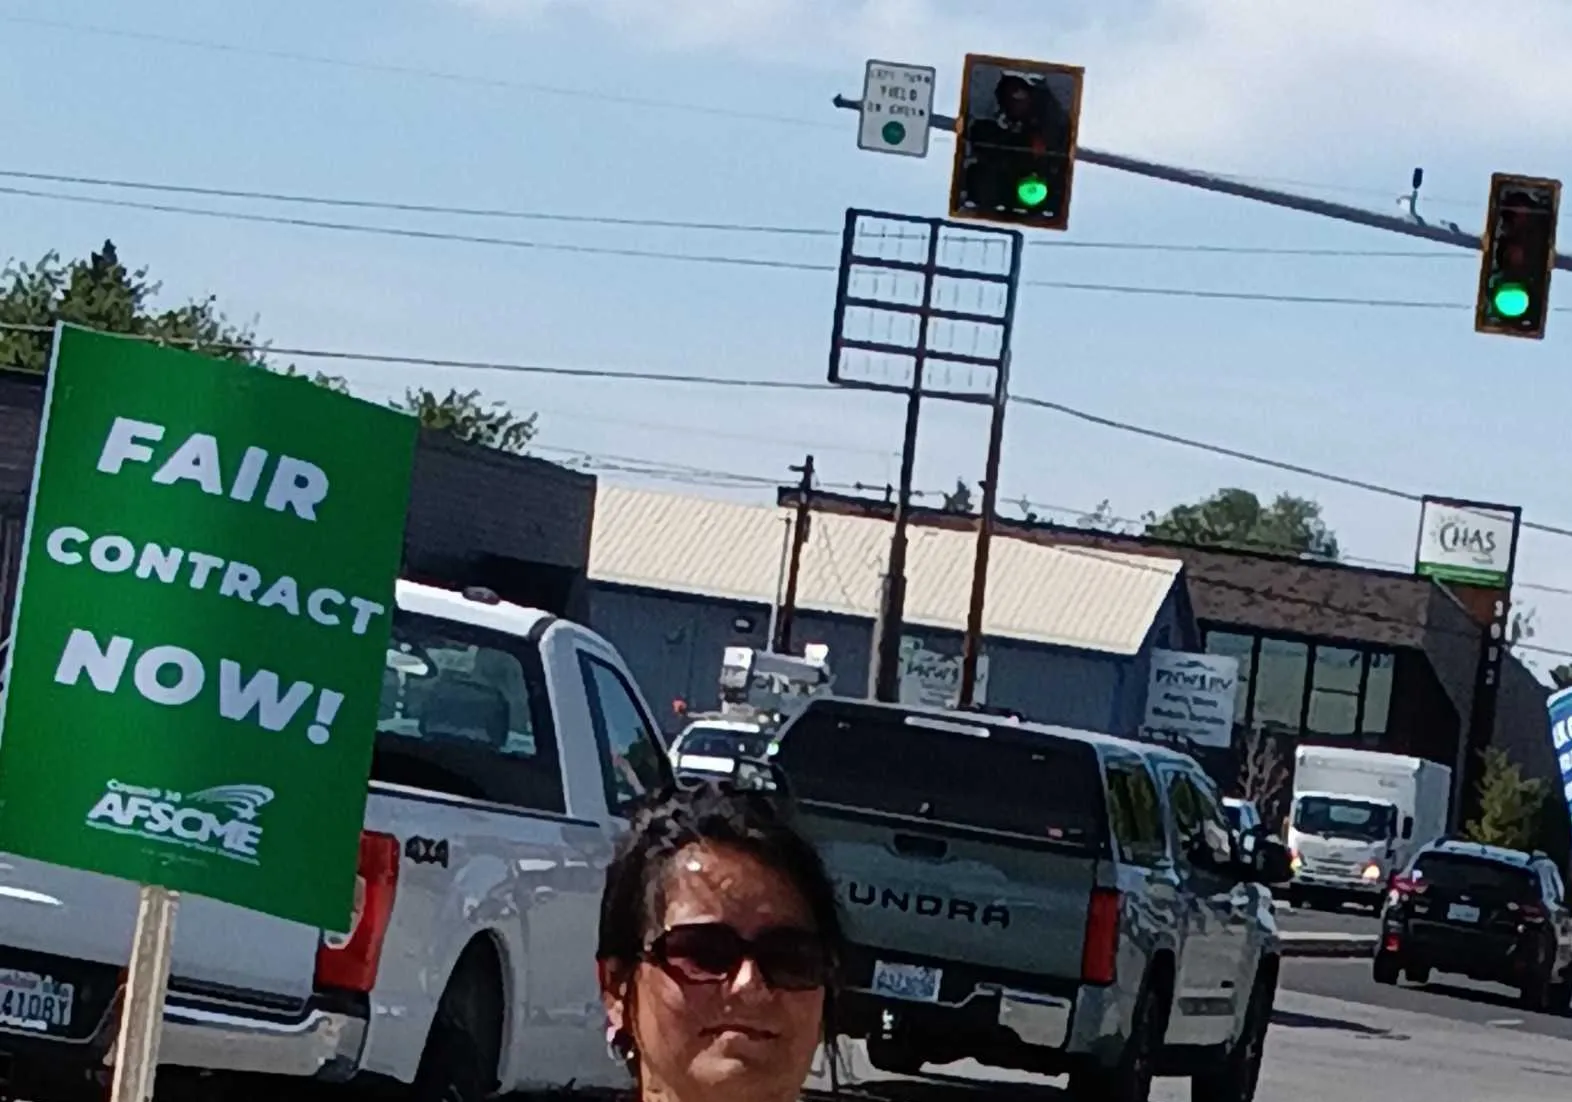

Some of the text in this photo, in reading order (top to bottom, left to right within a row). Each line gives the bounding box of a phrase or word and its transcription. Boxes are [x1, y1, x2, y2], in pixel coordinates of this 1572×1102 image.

[96, 416, 330, 522] FAIR
[1439, 521, 1497, 553] CHAS
[46, 526, 385, 635] CONTRACT
[53, 628, 345, 745] NOW!
[87, 791, 264, 856] AFSCME
[849, 880, 1011, 930] UNDRA
